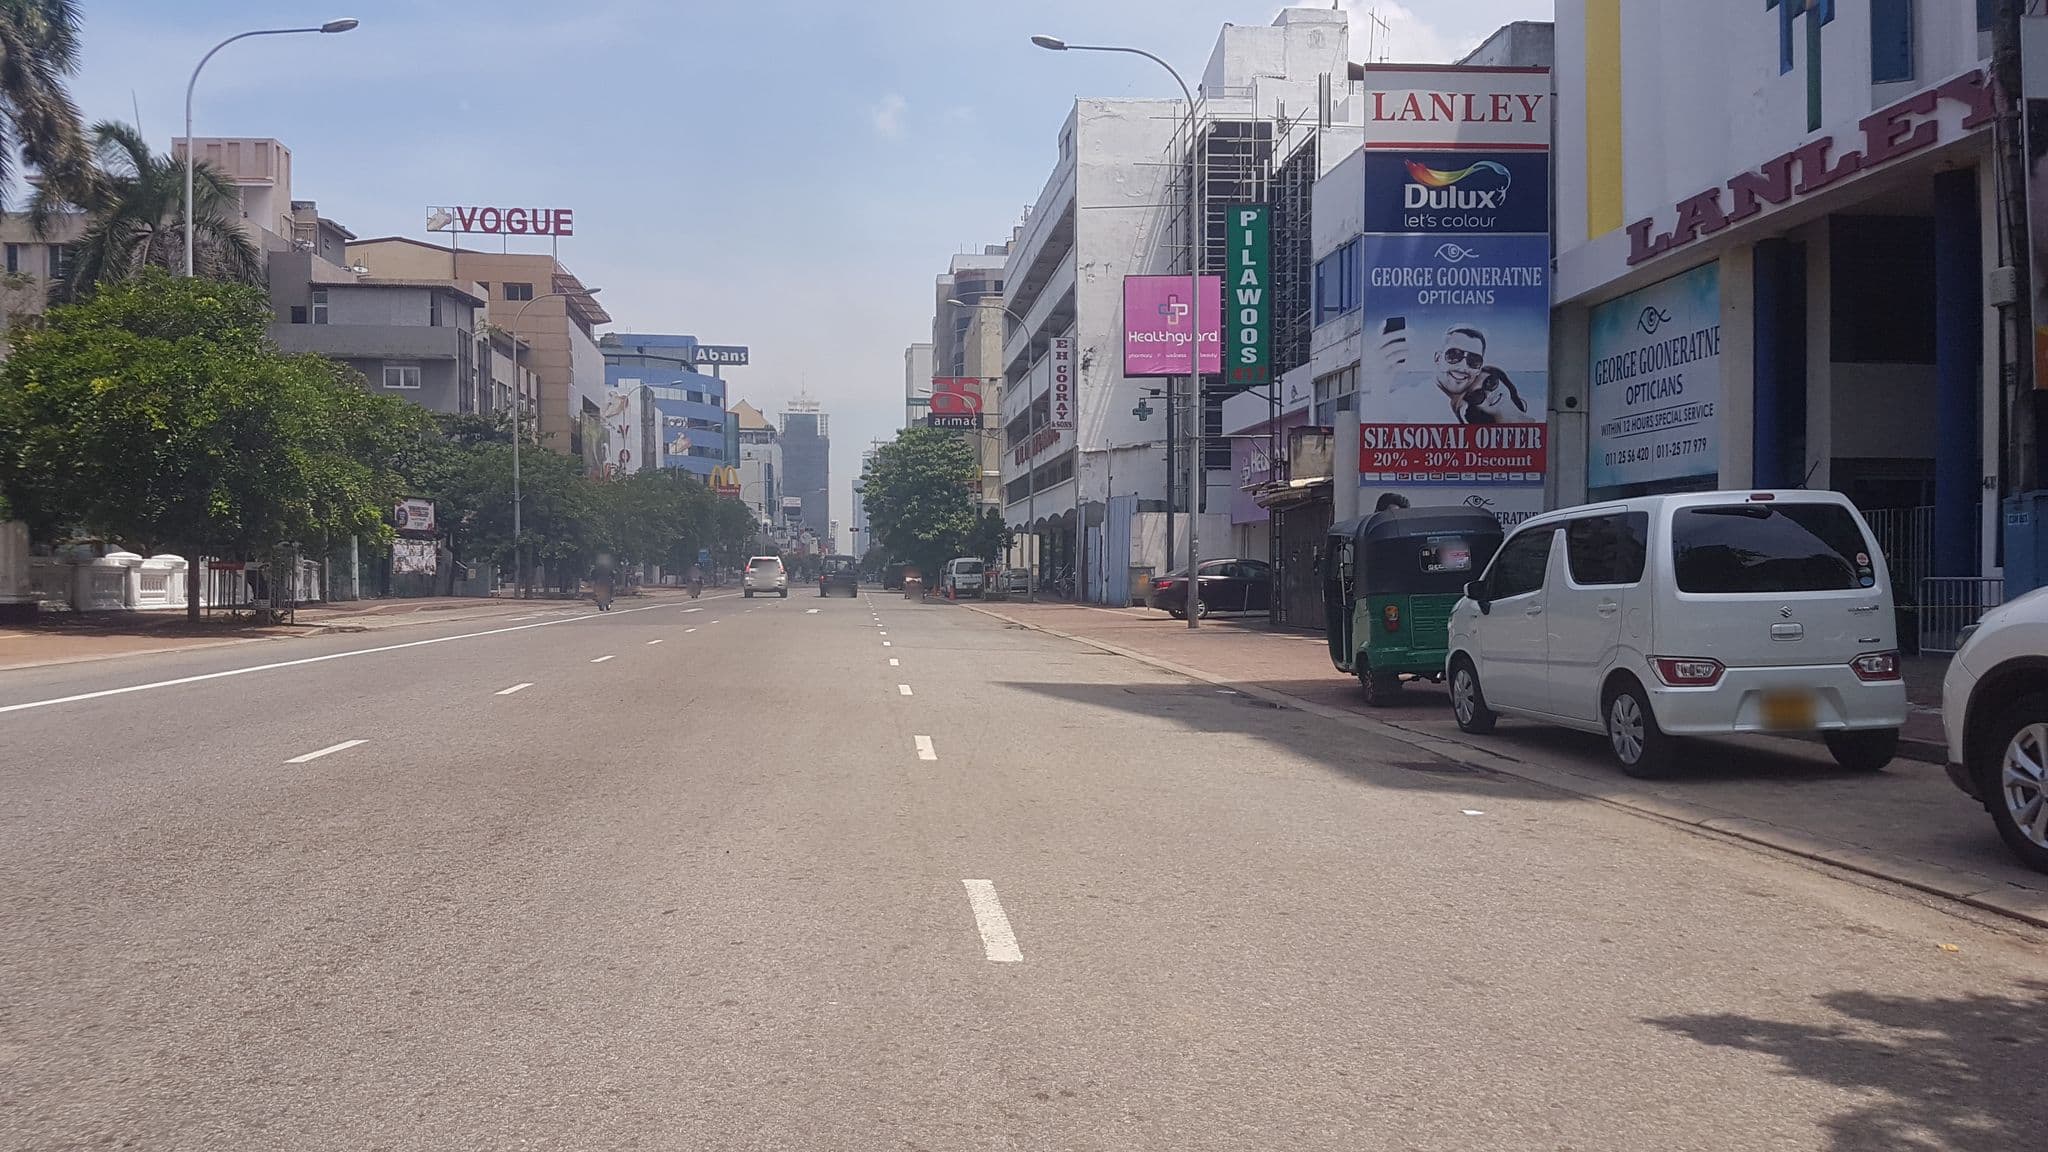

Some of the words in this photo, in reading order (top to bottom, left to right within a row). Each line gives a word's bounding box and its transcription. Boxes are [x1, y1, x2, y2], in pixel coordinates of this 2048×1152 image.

[1372, 92, 1544, 123] LANLEY
[1626, 69, 1996, 266] LANLEY
[1404, 183, 1496, 209] Dulux
[456, 206, 573, 236] VOGUE
[1404, 214, 1437, 228] let's
[1441, 213, 1497, 228] colour
[1236, 210, 1262, 363] PILAWOOS
[1371, 267, 1433, 287] GEORGE
[1437, 266, 1542, 287] GOONERATNE
[1418, 290, 1495, 305] OPTICIANS
[696, 348, 746, 362] Abans
[1595, 350, 1637, 386] GEORGE
[1640, 326, 1720, 375] GOONERATNE
[1626, 373, 1684, 405] OPTICIANS
[934, 417, 977, 427] arimac
[1601, 421, 1621, 437] WITHIN
[1623, 420, 1630, 432] 12
[1631, 415, 1653, 432] HOURS
[1655, 410, 1682, 427] SPECIAL
[1684, 403, 1714, 421] SERVICE
[1364, 427, 1469, 449] SEASONAL
[1475, 427, 1542, 449] OFFER
[1373, 452, 1408, 467] 20%
[1424, 452, 1459, 467] 30%
[1465, 452, 1532, 466] Discount
[1605, 452, 1616, 467] 011
[1618, 450, 1626, 464] 25
[1637, 446, 1649, 461] 420
[1682, 440, 1692, 455] 77
[1693, 438, 1707, 453] 979
